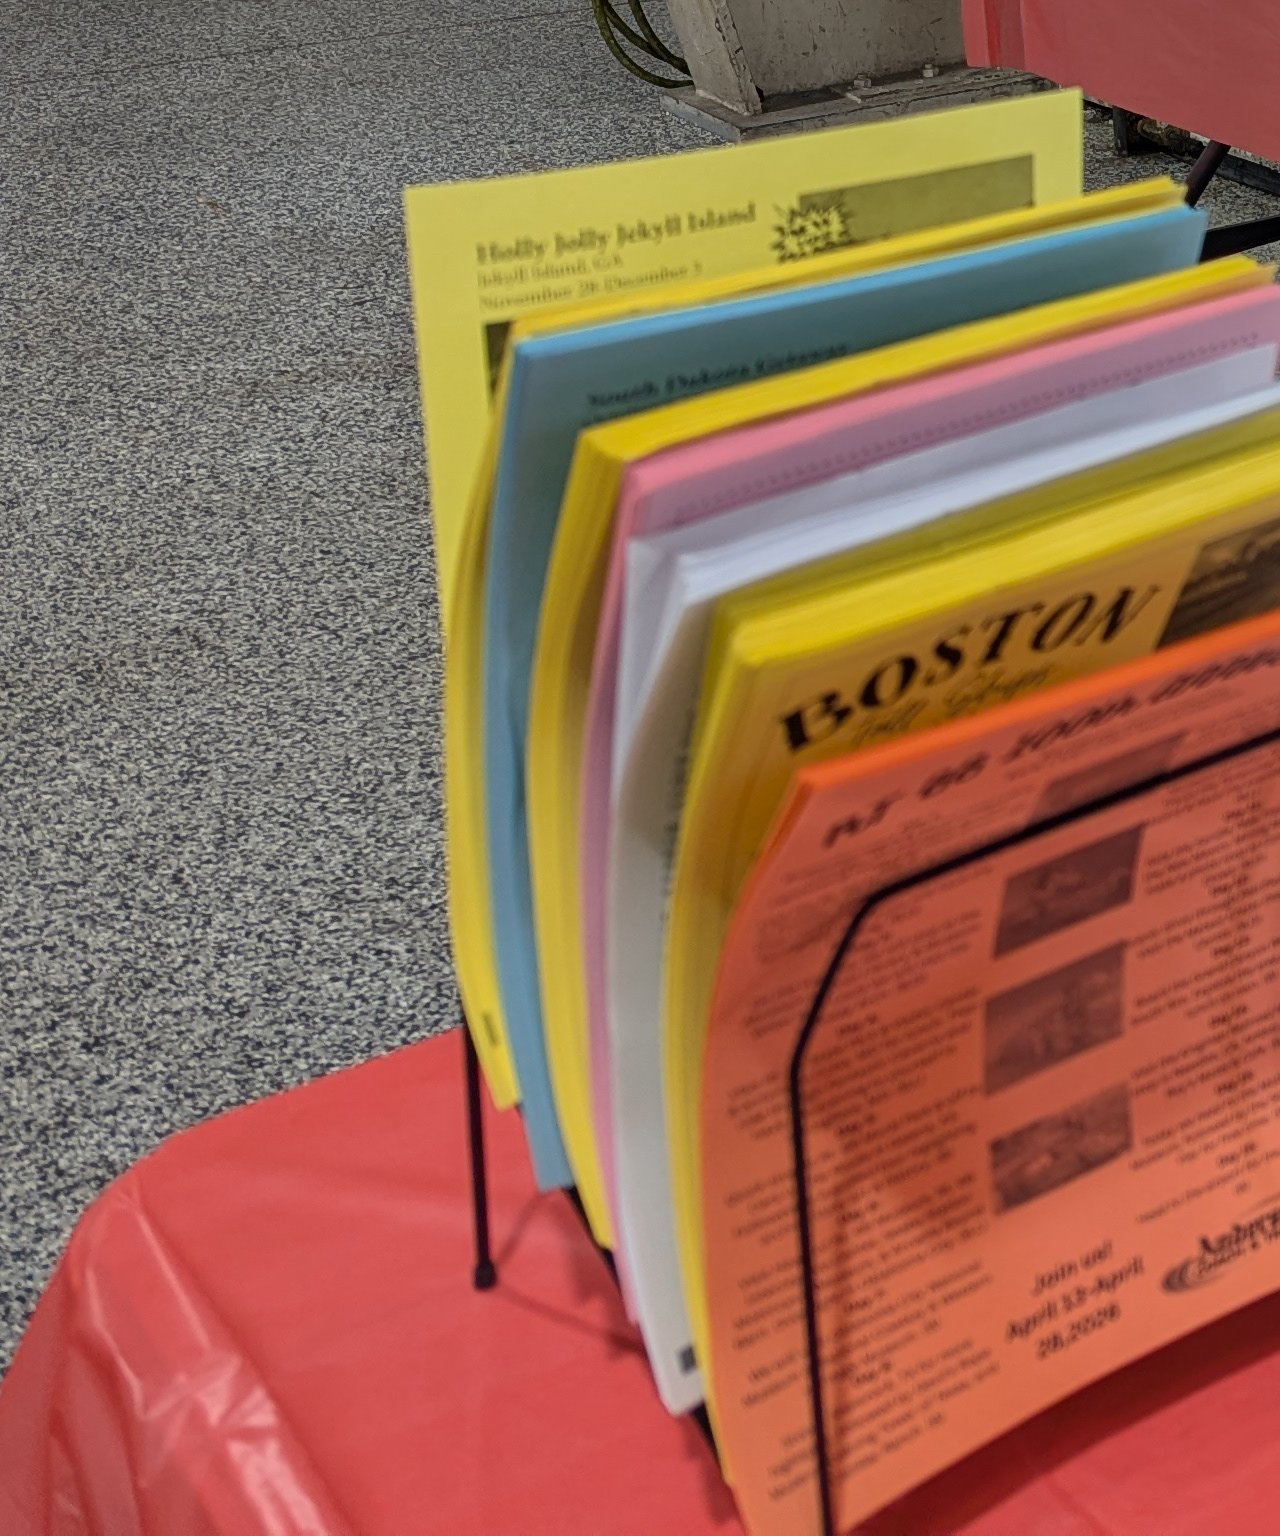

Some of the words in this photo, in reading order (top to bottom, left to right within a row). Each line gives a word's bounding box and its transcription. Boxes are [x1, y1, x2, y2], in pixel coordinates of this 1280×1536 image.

[476, 236, 548, 264] Holly
[554, 227, 610, 259] Jolly
[616, 214, 682, 248] Jekyll
[688, 200, 756, 230] Island
[776, 582, 1164, 753] BOSTON
[1031, 1259, 1078, 1296] Join
[1005, 1301, 1058, 1342] April
